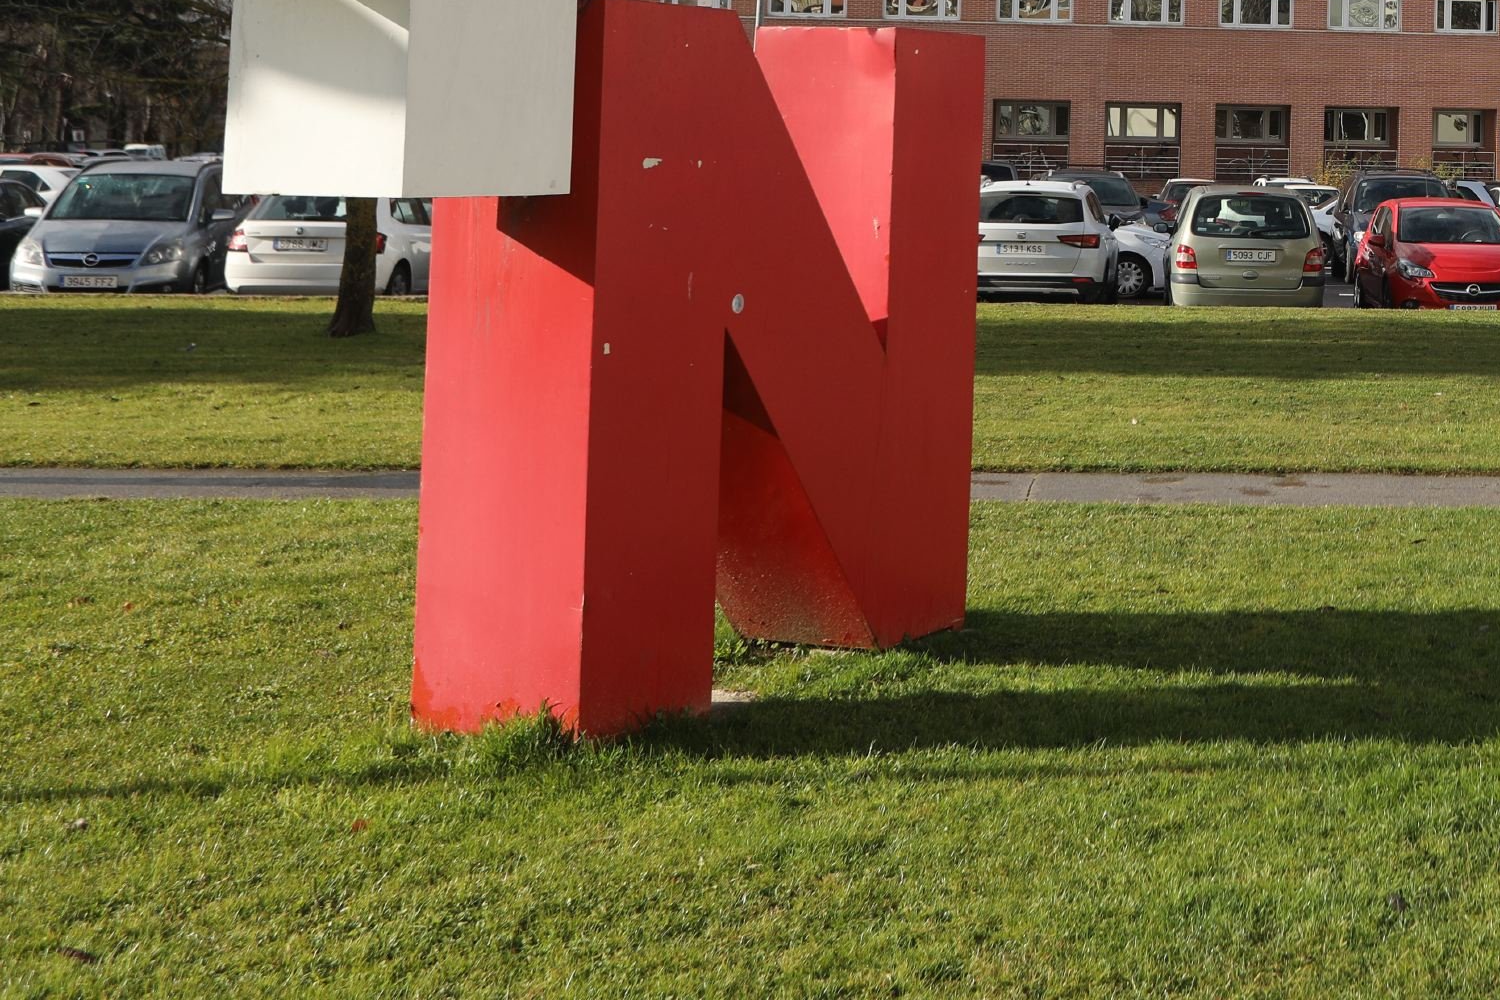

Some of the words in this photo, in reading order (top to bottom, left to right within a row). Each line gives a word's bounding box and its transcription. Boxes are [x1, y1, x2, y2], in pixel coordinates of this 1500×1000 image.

[1002, 244, 1024, 253] 5131
[1026, 244, 1042, 253] KSS
[1232, 251, 1253, 260] 5093
[1257, 251, 1273, 260] CJF
[66, 277, 91, 287] 3945
[95, 277, 114, 287] FFZ
